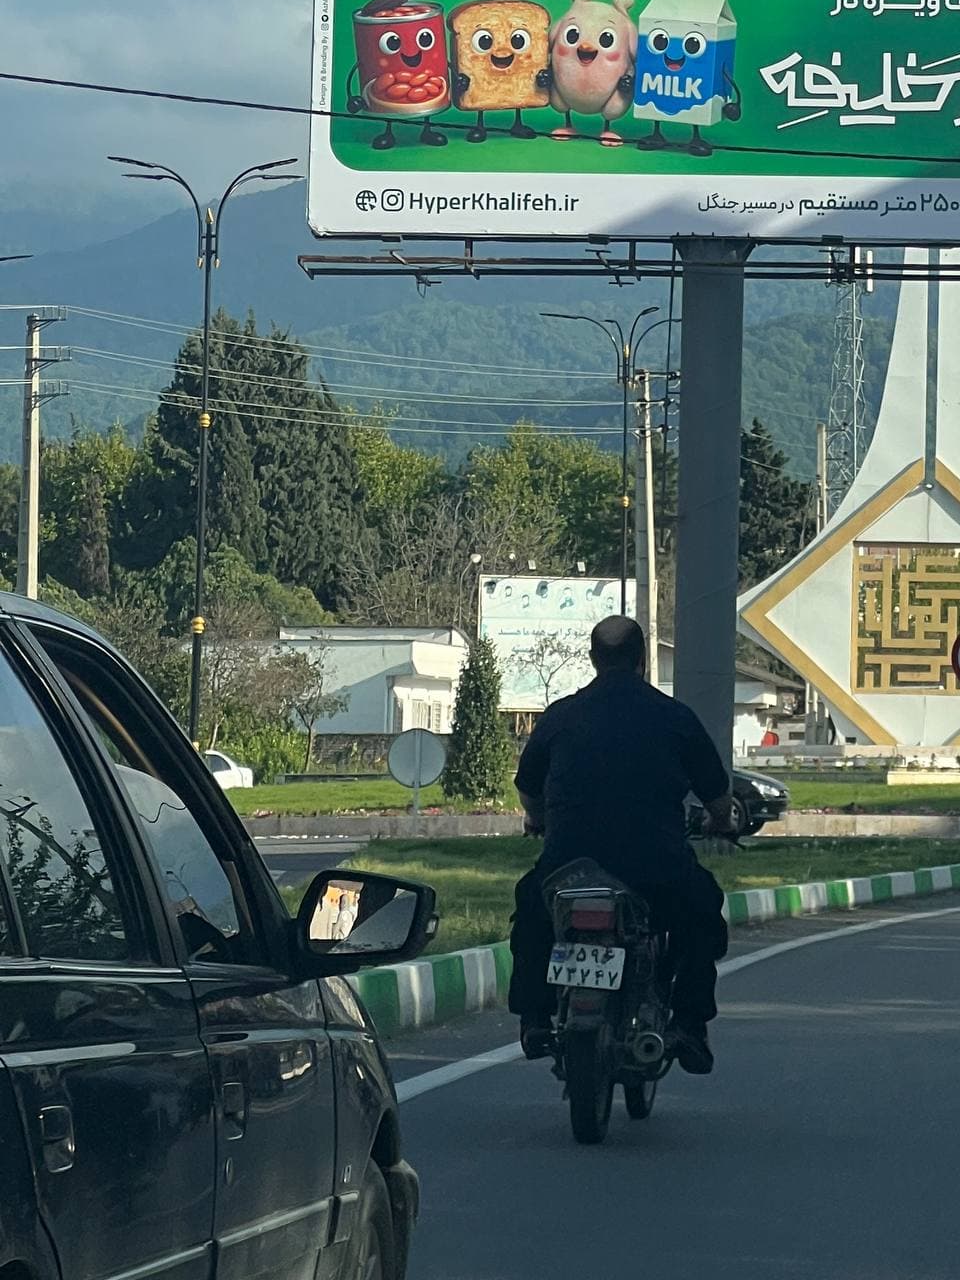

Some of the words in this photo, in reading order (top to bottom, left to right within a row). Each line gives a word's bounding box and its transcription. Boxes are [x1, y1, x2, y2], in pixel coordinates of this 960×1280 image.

[641, 72, 702, 100] MILK
[408, 191, 580, 214] HyperKhalifeh.ir
[697, 193, 738, 213] جنگل
[740, 199, 777, 213] مسیر
[778, 199, 794, 213] در
[799, 193, 879, 216] مستقیم
[880, 196, 917, 217] متر
